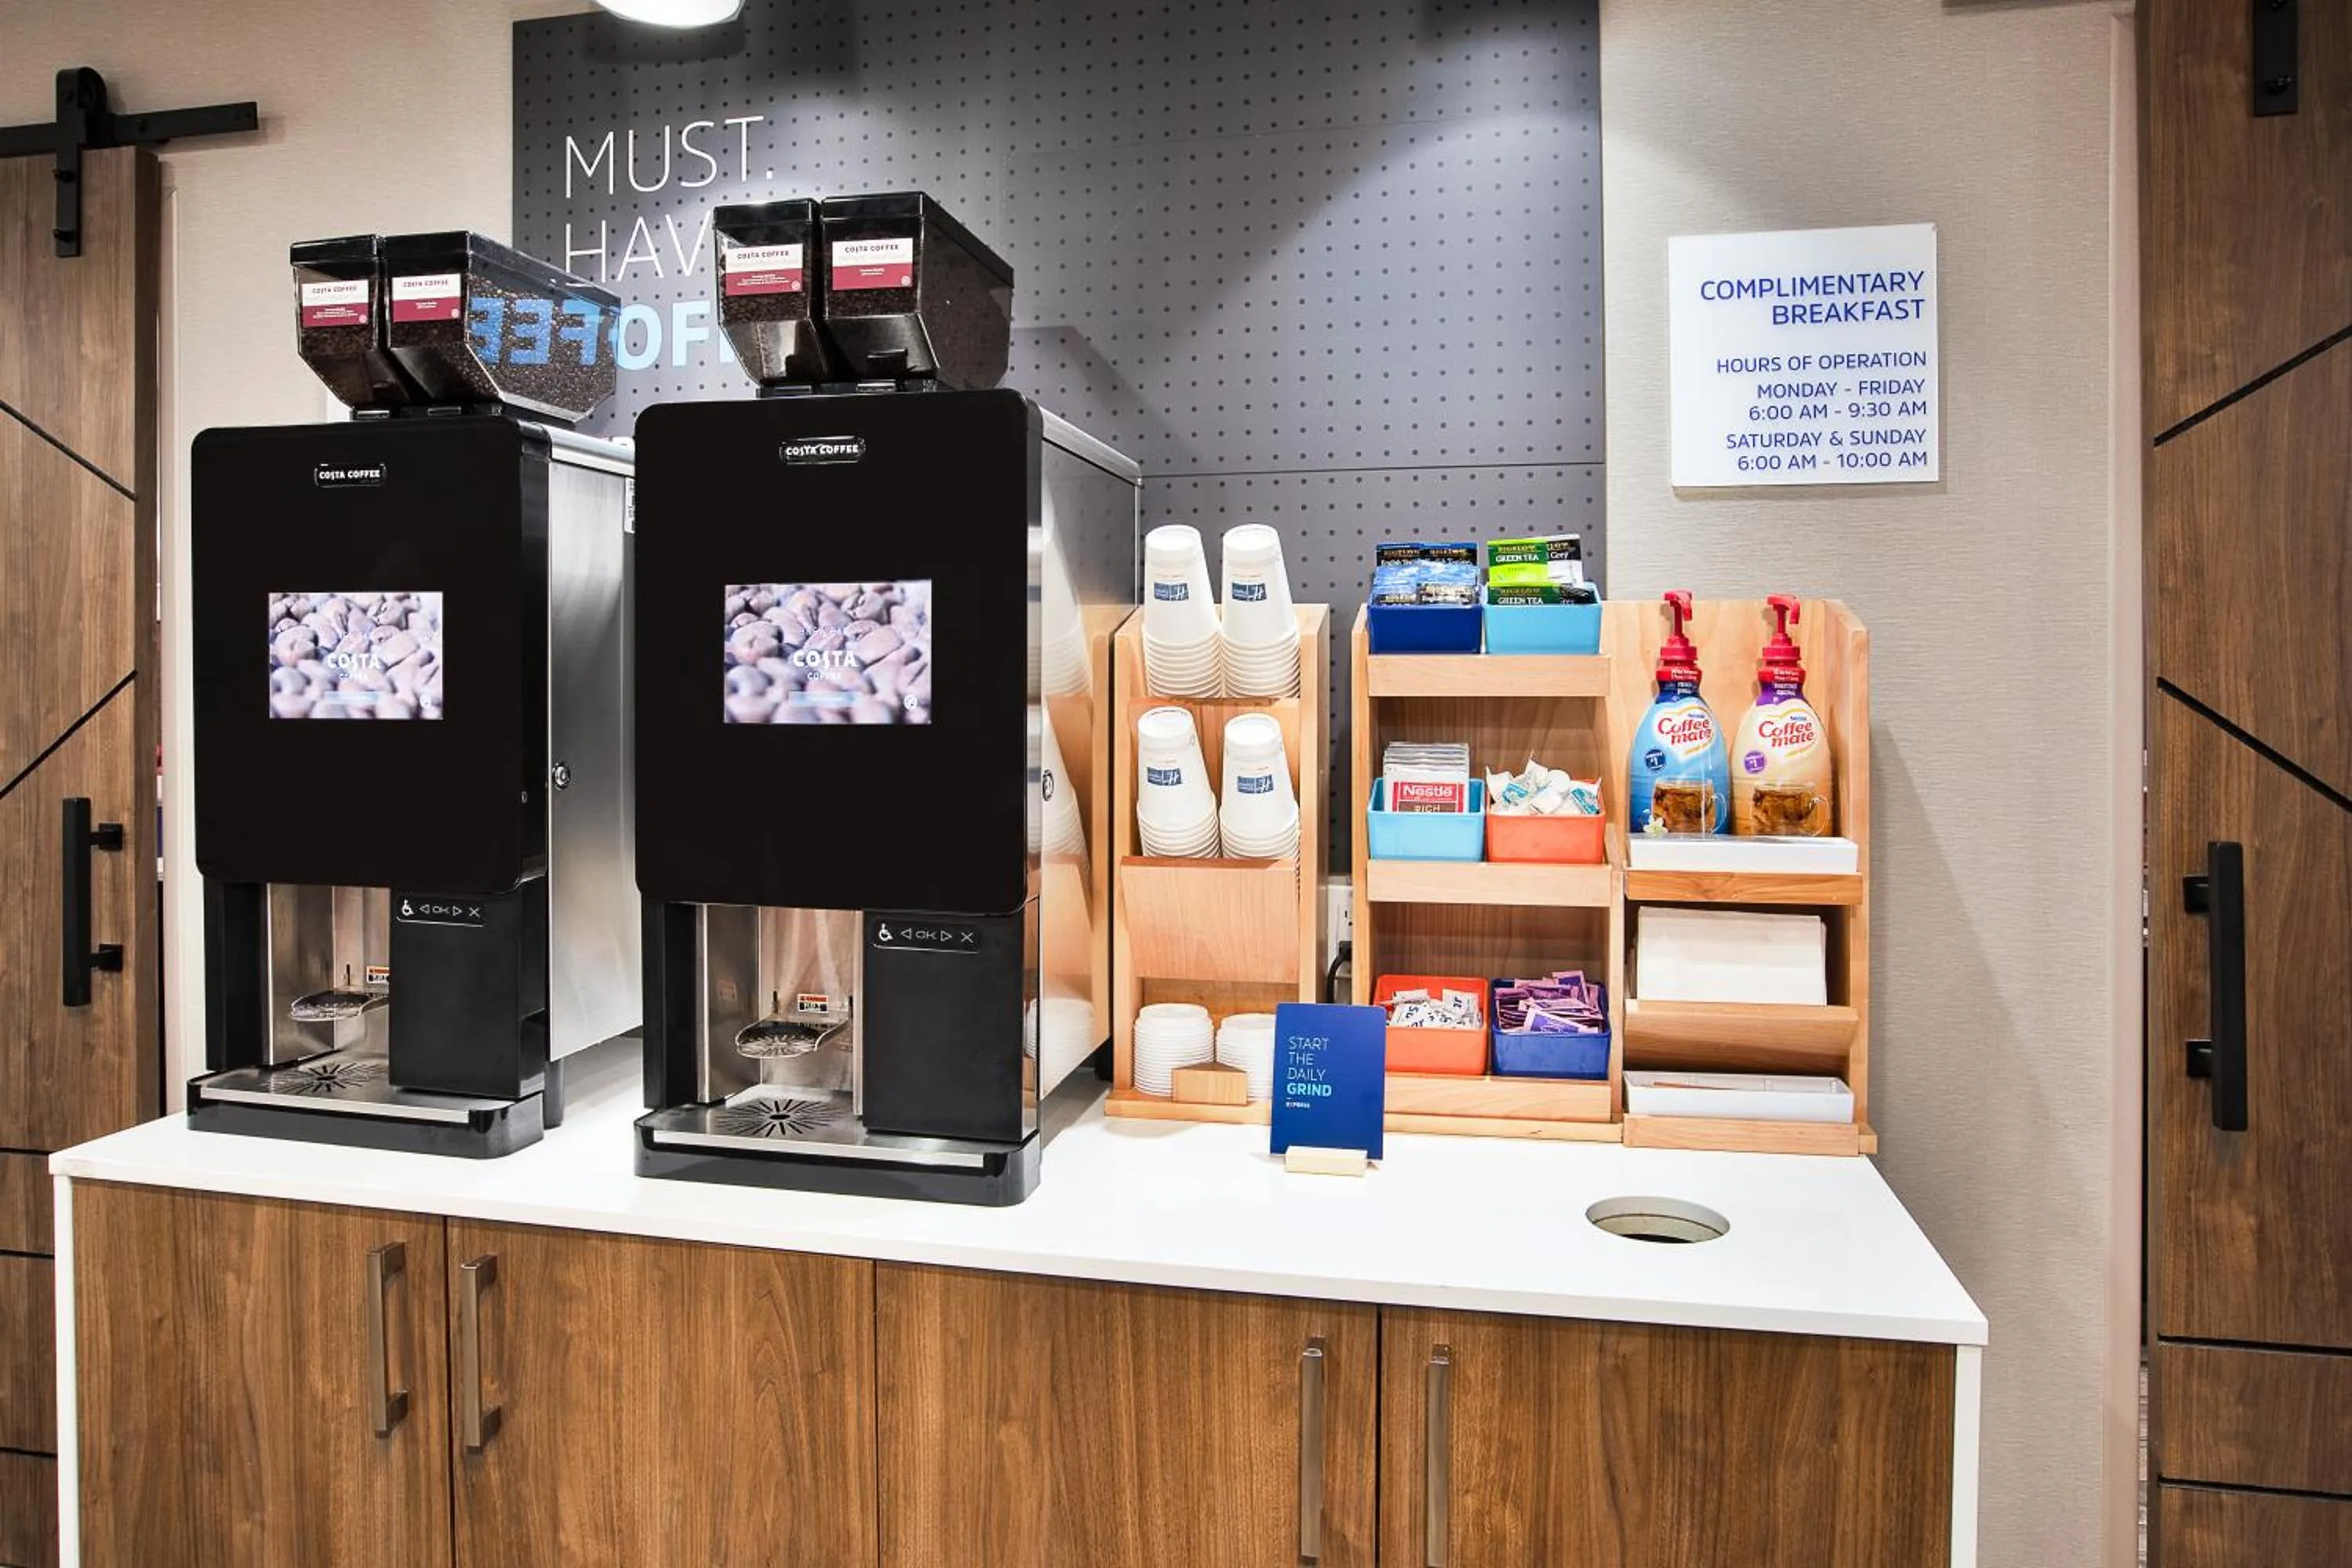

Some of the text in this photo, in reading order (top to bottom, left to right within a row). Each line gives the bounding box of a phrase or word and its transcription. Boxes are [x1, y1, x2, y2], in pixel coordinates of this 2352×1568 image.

[564, 115, 773, 198] MUST.
[564, 209, 712, 283] HAV
[1700, 270, 1925, 301] COMPLIMENTARY
[1773, 299, 1926, 325] BREAKFAST
[1717, 351, 1927, 373] HOURS OF OPERATION
[1757, 381, 1838, 399] MONDAY
[1859, 379, 1926, 396] FRIDAY
[1749, 405, 1793, 421] 6:00
[1798, 404, 1828, 419] AM
[1848, 401, 1891, 418] 9:30
[1898, 401, 1927, 416] AM
[1726, 429, 1926, 449] SATURDAY & SUNDAY
[786, 444, 858, 456] COSTA COFFEE
[1737, 455, 1781, 471] 6:00
[1788, 454, 1817, 470] AM
[1837, 452, 1892, 468] 10:00
[1898, 451, 1928, 466] AM
[347, 470, 380, 479] COFFEE
[793, 650, 859, 672] COSTA
[1657, 717, 1710, 735] Coffee
[1759, 720, 1812, 738] Coffee
[1671, 728, 1712, 746] mate
[1772, 731, 1814, 747] mate
[1414, 804, 1440, 813] RICH
[915, 931, 937, 940] OK
[1288, 1036, 1330, 1051] START
[1288, 1051, 1314, 1066] THE
[1287, 1067, 1327, 1082] DAILY
[1287, 1083, 1333, 1098] GRIND
